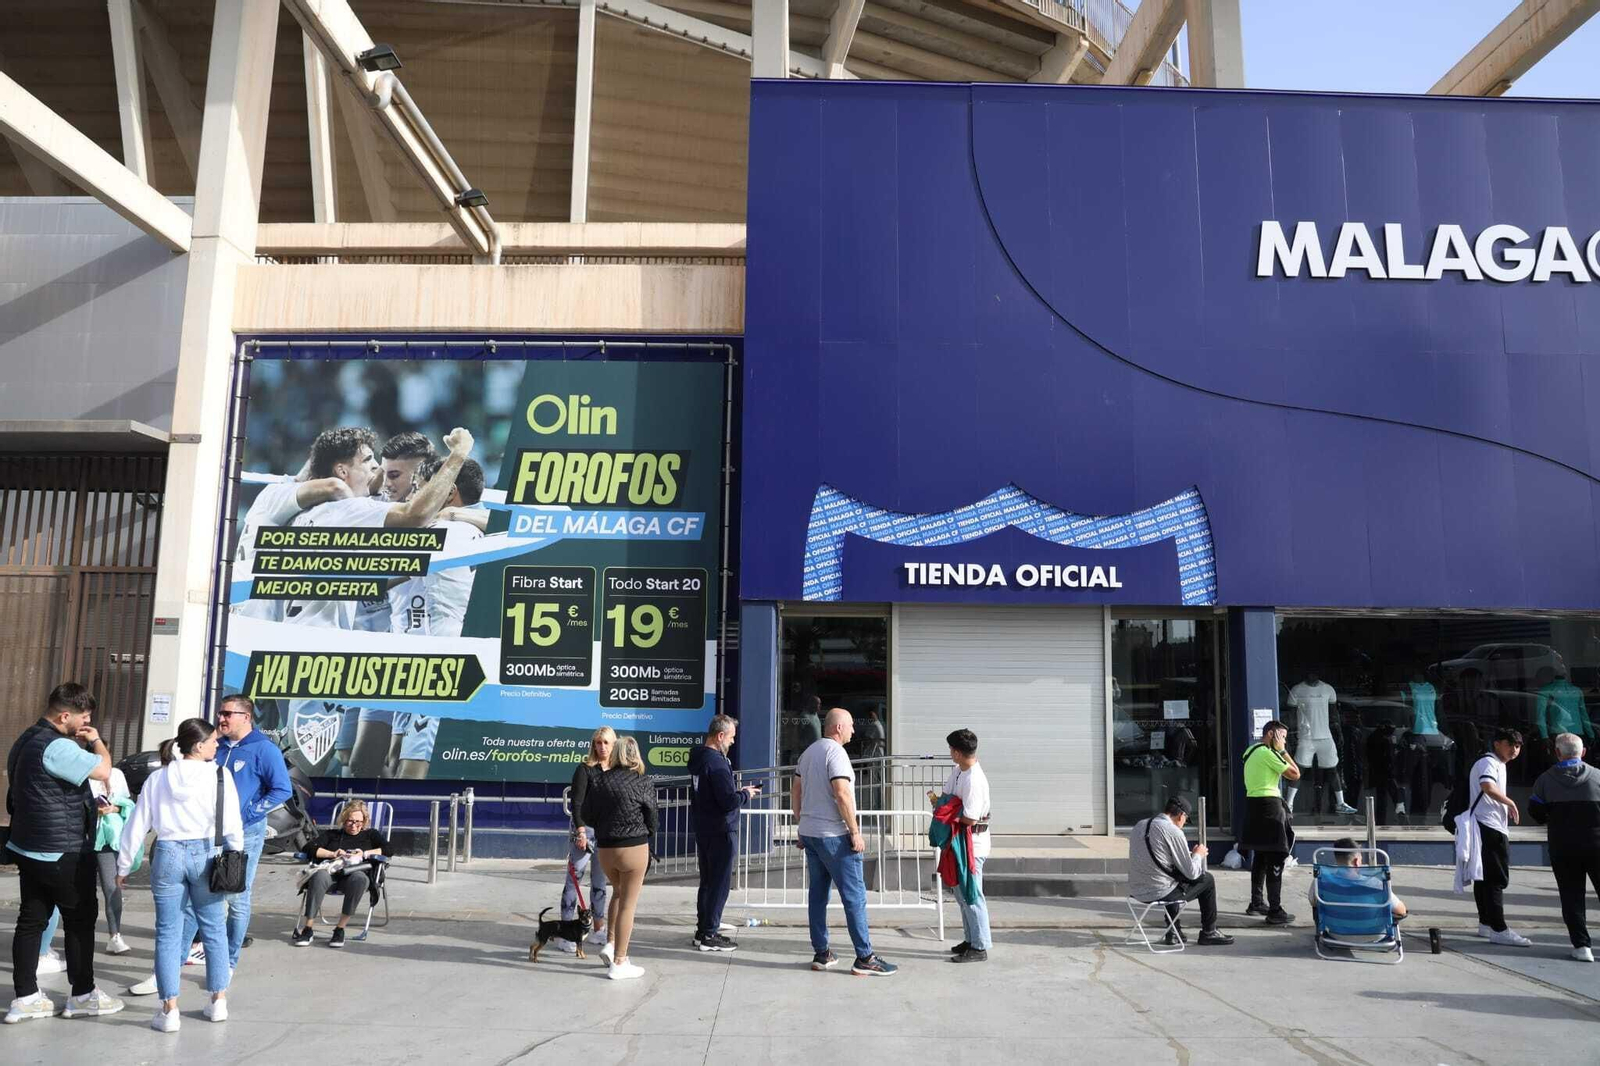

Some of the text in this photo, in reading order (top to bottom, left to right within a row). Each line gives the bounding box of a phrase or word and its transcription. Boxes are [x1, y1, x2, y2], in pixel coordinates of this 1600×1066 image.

[1256, 220, 1600, 283] MALAGA
[527, 394, 617, 434] Olin
[513, 452, 681, 505] FOROFOS
[824, 498, 850, 509] MALAGA
[976, 498, 998, 508] OFICIAL
[828, 511, 854, 524] MALAGA
[866, 510, 887, 519] TIENDA
[957, 517, 979, 527] TIENDA
[980, 510, 1002, 520] OFICIAL
[1004, 502, 1029, 513] MALAGA
[1044, 512, 1066, 522] TIENDA
[1135, 519, 1156, 530] TIENDA
[1157, 511, 1178, 522] OFICIAL
[515, 512, 700, 535] DEL MÁLAGA CF
[869, 522, 891, 532] TIENDA
[892, 515, 915, 525] OFICIAL
[896, 528, 919, 538] OFICIAL
[920, 520, 946, 531] MALAGA
[1049, 525, 1070, 535] TIENDA
[1071, 518, 1093, 528] OFICIAL
[808, 533, 831, 543] OFICIAL
[832, 524, 858, 536] MALAGA
[925, 533, 950, 544] MALAGA
[962, 530, 984, 540] TIENDA
[984, 523, 1006, 534] OFICIAL
[1076, 531, 1098, 541] OFICIAL
[1099, 522, 1124, 534] MALAGA
[1140, 532, 1161, 542] TIENDA
[1161, 524, 1183, 535] OFICIAL
[260, 532, 442, 550] POR SER MALAGUISTA,
[1103, 535, 1129, 547] MALAGA
[812, 544, 835, 556] OFICIAL
[260, 556, 421, 572] TE DAMOS NUESTRA
[816, 558, 839, 568] OFICIAL
[512, 576, 583, 589] Fibra Start
[904, 562, 1122, 588] TIENDA OFICIAL
[1181, 576, 1202, 586] OFICIAL
[256, 581, 378, 596] MEJOR OFERTA
[608, 577, 700, 590] Todo Start 20
[1185, 589, 1207, 599] OFICIAL
[411, 595, 426, 628] Olin
[506, 602, 579, 647] 15 €
[607, 604, 679, 648] 19 €
[250, 654, 465, 700] ¡VA POR USTEDES!
[506, 664, 556, 676] 300Mb
[610, 665, 661, 678] 300Mb
[522, 690, 552, 698] Definitivo
[610, 688, 649, 701] 20GB
[482, 736, 590, 748] Toda nuestra oferta en
[649, 734, 693, 744] Llámanos
[658, 751, 690, 763] 1560
